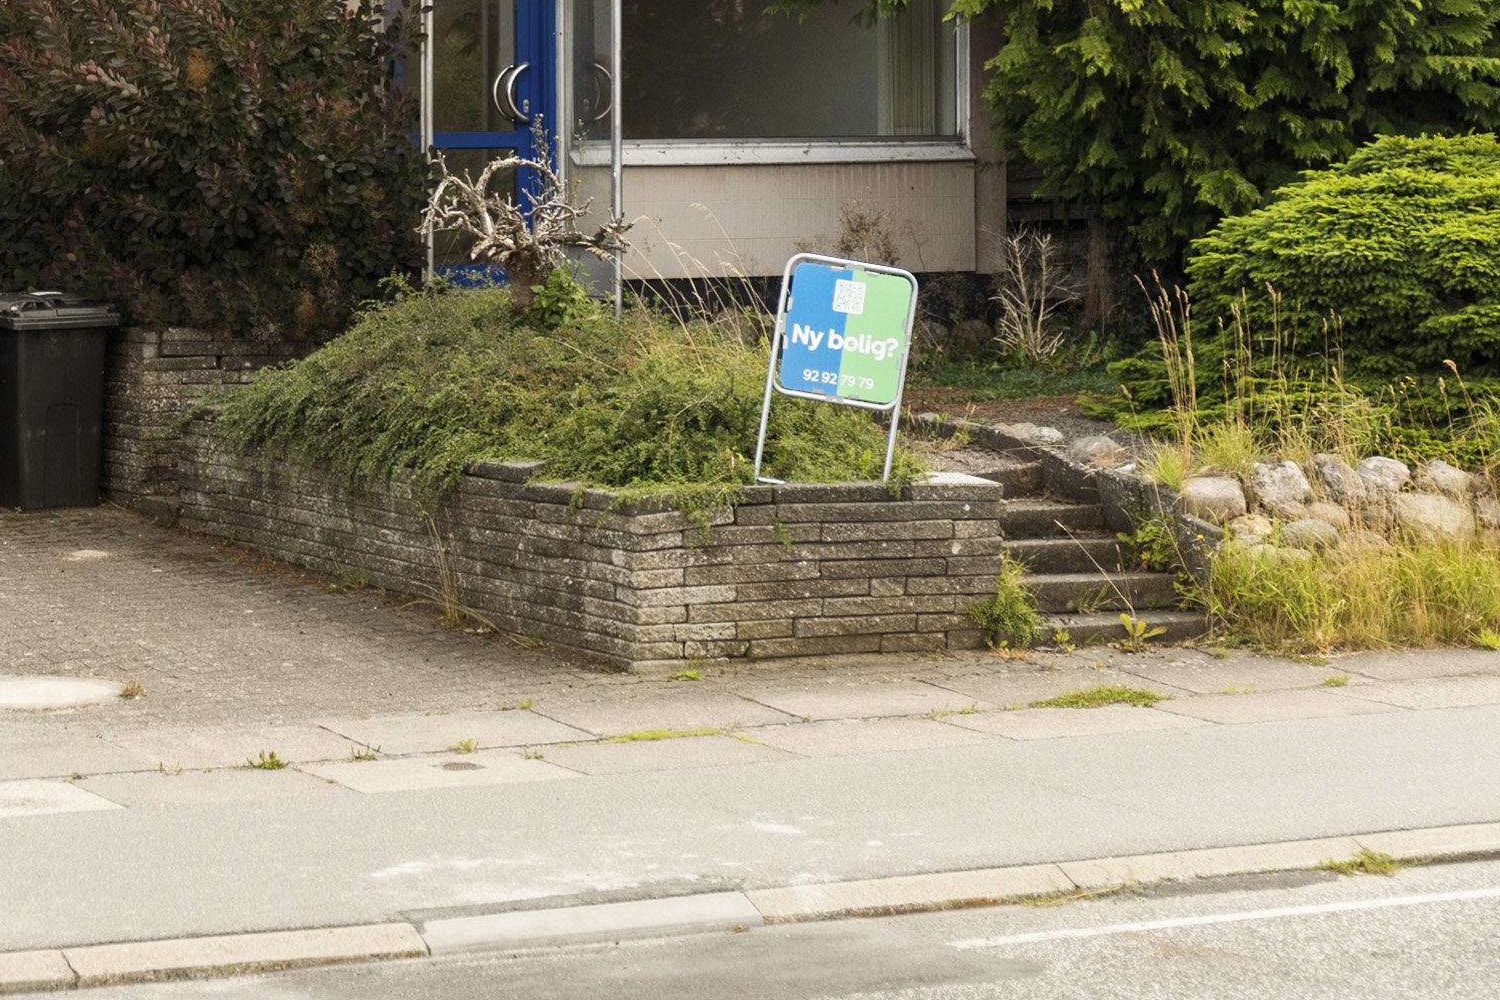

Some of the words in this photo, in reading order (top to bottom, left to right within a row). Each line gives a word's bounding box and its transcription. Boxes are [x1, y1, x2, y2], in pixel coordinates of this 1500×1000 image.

[791, 323, 825, 351] Ny
[827, 328, 899, 361] bolig?
[803, 368, 819, 383] 92
[821, 371, 838, 385] 92
[840, 374, 856, 388] 79
[859, 376, 874, 390] 79
